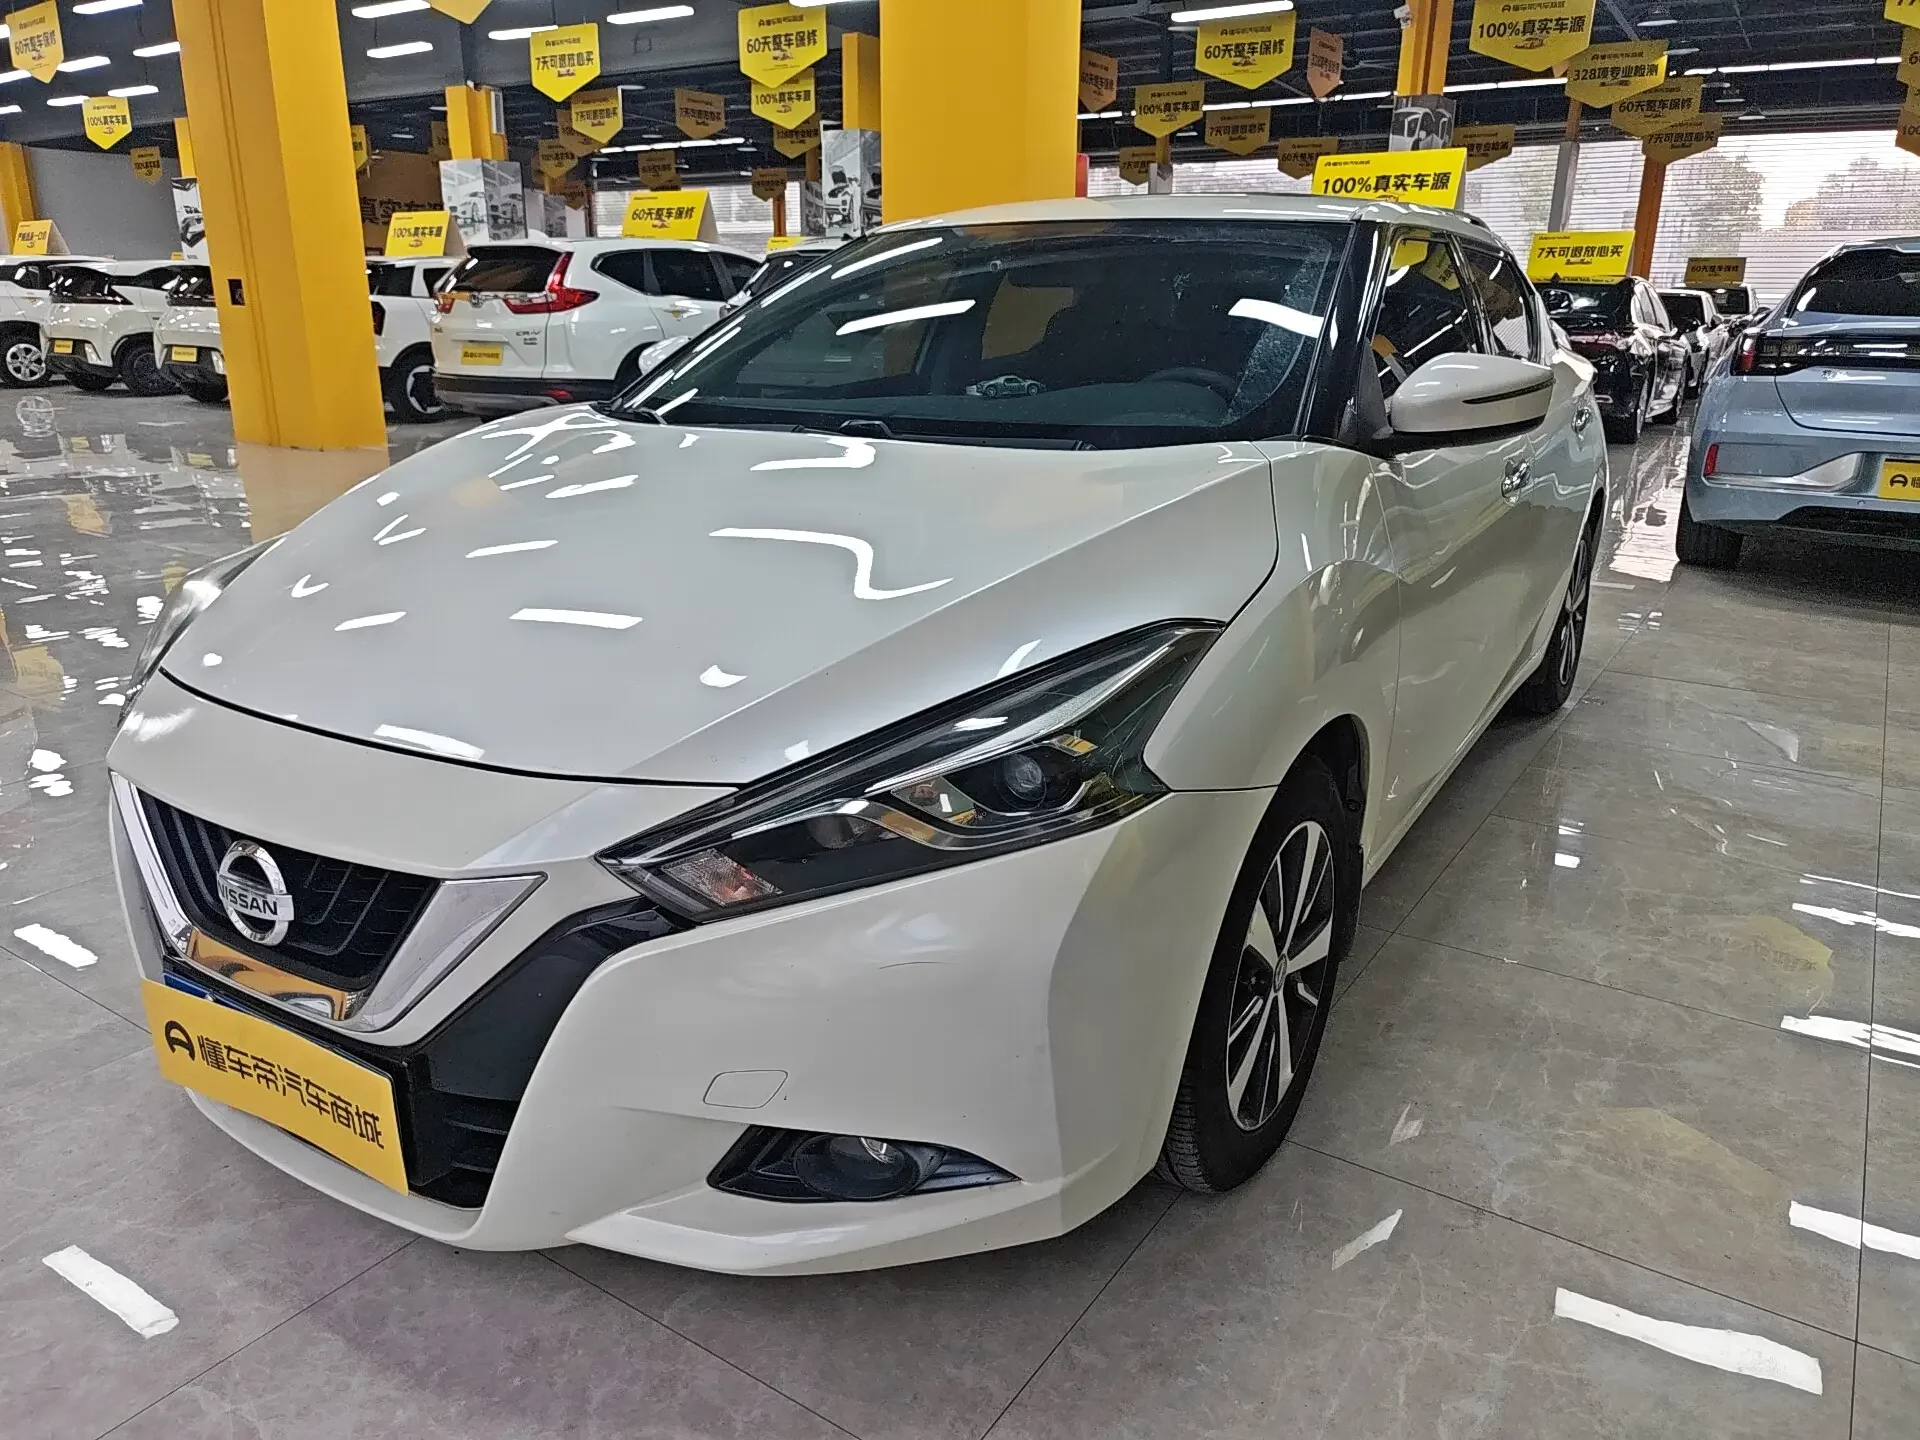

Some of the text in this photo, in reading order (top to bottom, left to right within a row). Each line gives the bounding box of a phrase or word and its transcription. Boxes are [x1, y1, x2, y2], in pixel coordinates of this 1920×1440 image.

[1478, 15, 1587, 38] 100%真实车源
[746, 29, 818, 53] 60天整车保修
[1204, 38, 1286, 59] 60天整车保修
[535, 51, 594, 70] 7天可退放心买
[1573, 63, 1658, 81] 328项专业检测
[1139, 101, 1200, 115] 100%真实车源
[1618, 97, 1694, 113] 60天整车保修
[1322, 171, 1452, 194] 100%真实车源
[631, 206, 696, 221] 60天整车保修
[1537, 244, 1624, 259] 7天可退放心买
[218, 880, 278, 916] NISSAN
[197, 1034, 384, 1150] 懂车帝汽车商城
